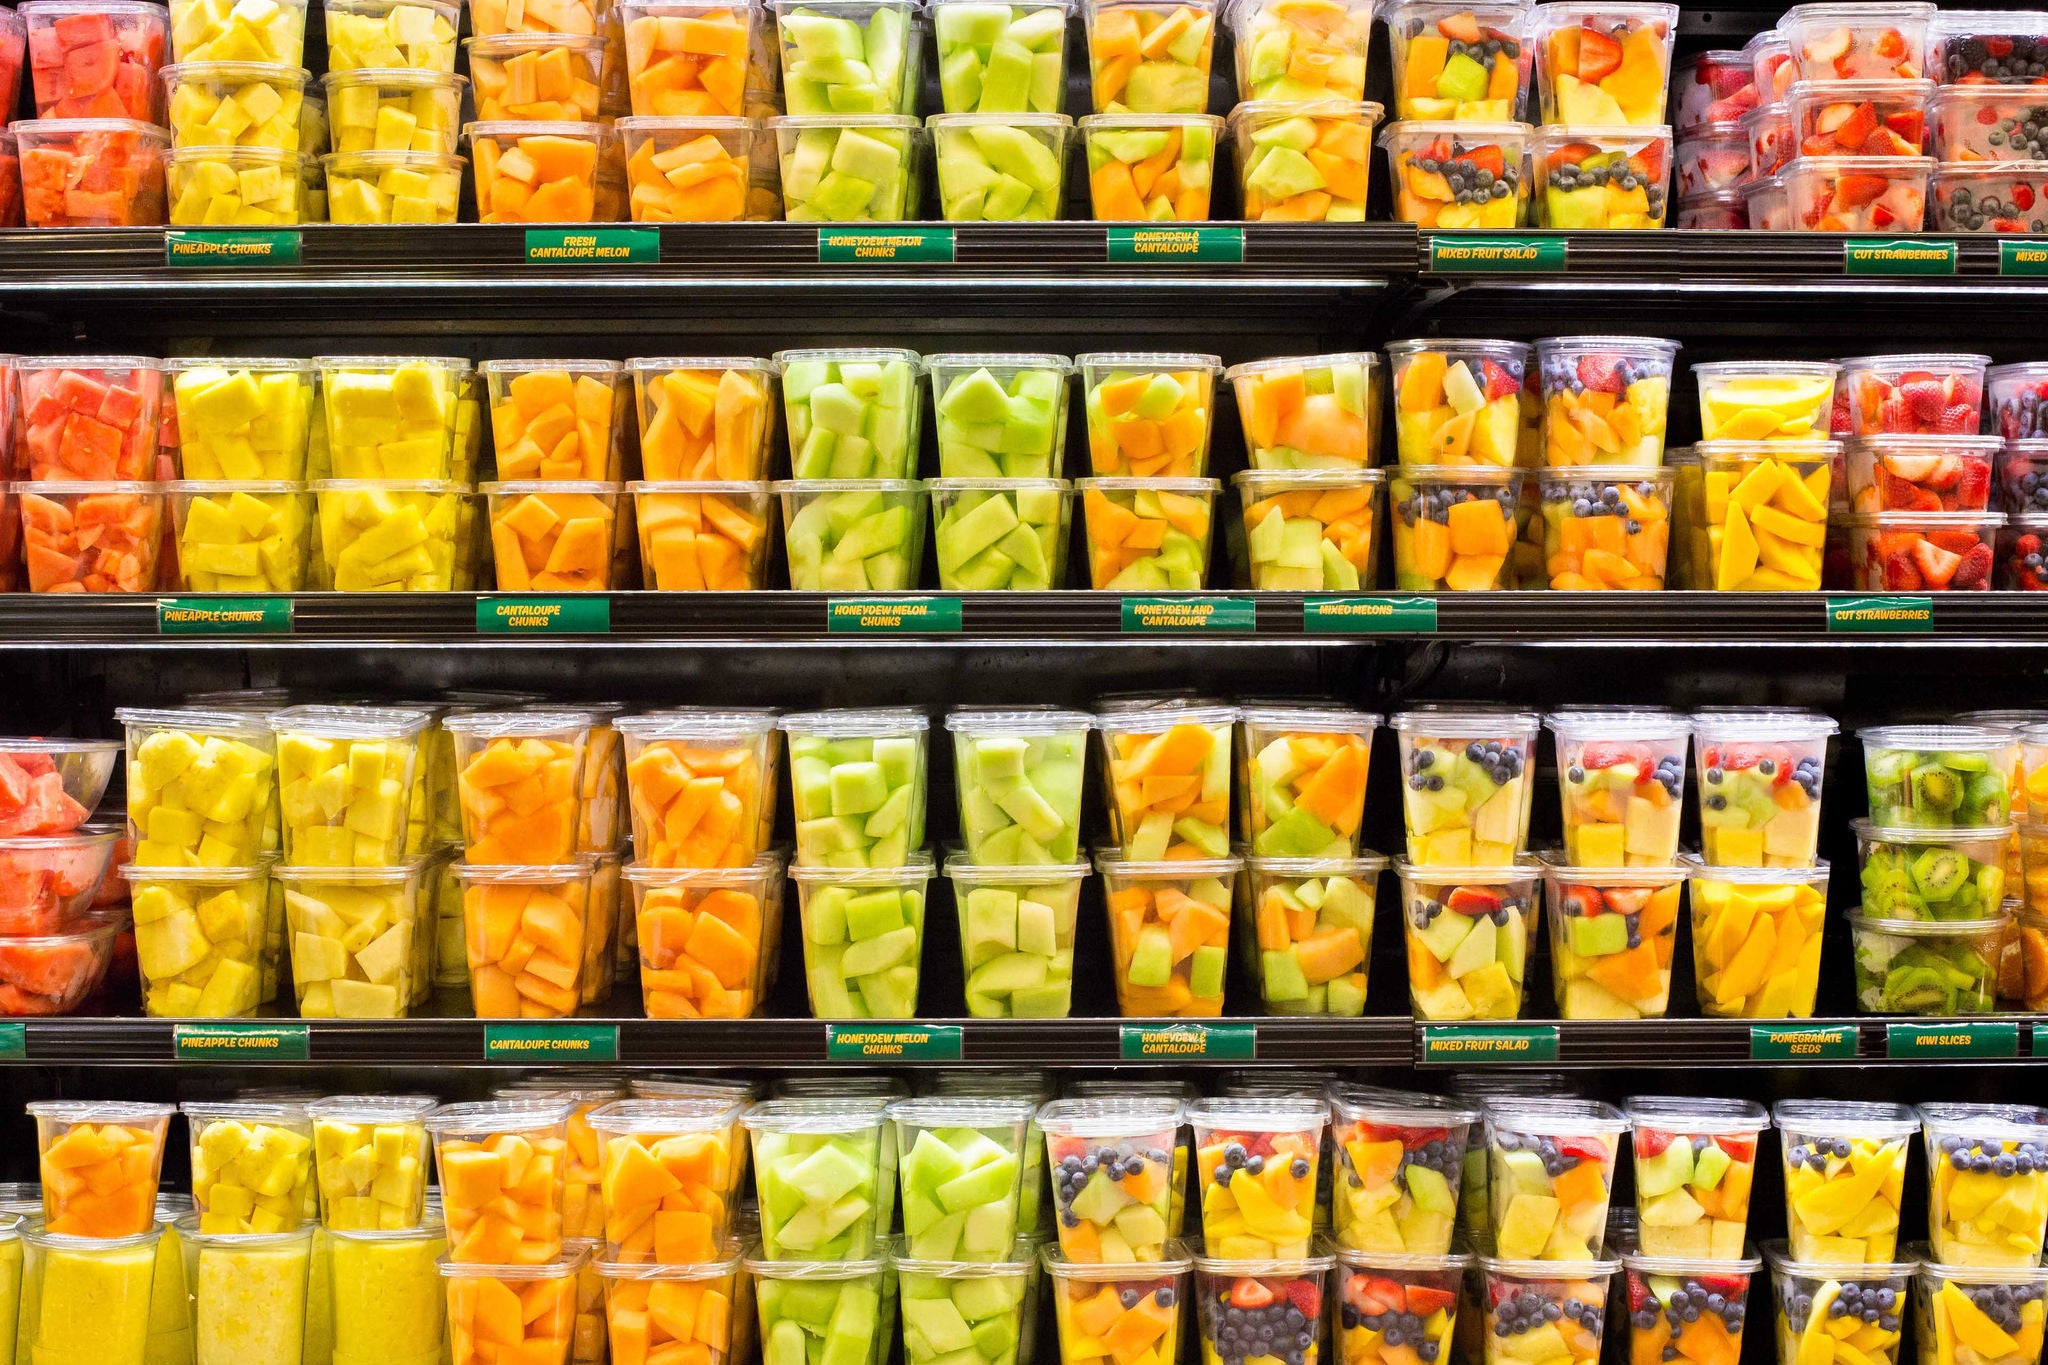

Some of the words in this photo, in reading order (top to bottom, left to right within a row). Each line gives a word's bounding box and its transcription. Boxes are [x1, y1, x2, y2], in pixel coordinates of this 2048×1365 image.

[563, 237, 596, 246] FRESH
[829, 236, 887, 246] HONEYDEW
[888, 237, 921, 247] MELON
[1134, 232, 1191, 242] HONEYDEW
[173, 243, 228, 253] PINEAPPLE
[229, 244, 271, 254] CHUNKS
[530, 247, 594, 257] CANTALOUPE
[596, 248, 630, 257] MELON
[855, 247, 895, 257] CHUNKS
[1134, 242, 1199, 252] CANTALOUPE
[1437, 248, 1471, 258] MIXED
[1472, 248, 1503, 258] FRUIT
[1503, 248, 1537, 259] SALAD
[1854, 250, 1874, 259] CUT
[1874, 250, 1948, 259] STRAWBERRIES
[2016, 251, 2047, 261] MIXED
[496, 606, 561, 615] CANTALOUPE
[835, 606, 892, 615] HONEYDEW
[892, 606, 927, 615] MELON
[1134, 605, 1192, 615] HONEYDEW
[1193, 605, 1214, 615] AND
[1319, 605, 1351, 614] MIXED
[1352, 605, 1393, 614] MELONS
[165, 611, 220, 621] PINEAPPLE
[221, 611, 263, 621] CHUNKS
[1142, 615, 1207, 625] CANTALOUPE
[1836, 610, 1854, 620] CUT
[1856, 610, 1930, 619] STRAWBERRIES
[508, 617, 549, 626] CHUNKS
[860, 616, 901, 626] CHUNKS
[181, 1038, 236, 1047] PINEAPPLE
[238, 1038, 279, 1047] CHUNKS
[837, 1034, 894, 1043] HONEYDEW
[894, 1034, 928, 1043] MELON
[1142, 1033, 1200, 1043] HONEYDEW
[1770, 1033, 1842, 1043] POMEGRANATE
[1916, 1036, 1938, 1045] KIWI
[1939, 1035, 1971, 1045] SLICES
[490, 1040, 550, 1049] CANTALOUPE
[552, 1040, 589, 1049] CHUNKS
[862, 1045, 902, 1054] CHUNKS
[1142, 1043, 1206, 1053] CANTALOUPE
[1431, 1040, 1463, 1051] MIXED
[1464, 1039, 1495, 1050] FRUIT
[1495, 1039, 1529, 1050] SALAD
[1790, 1044, 1821, 1053] SEEDS
